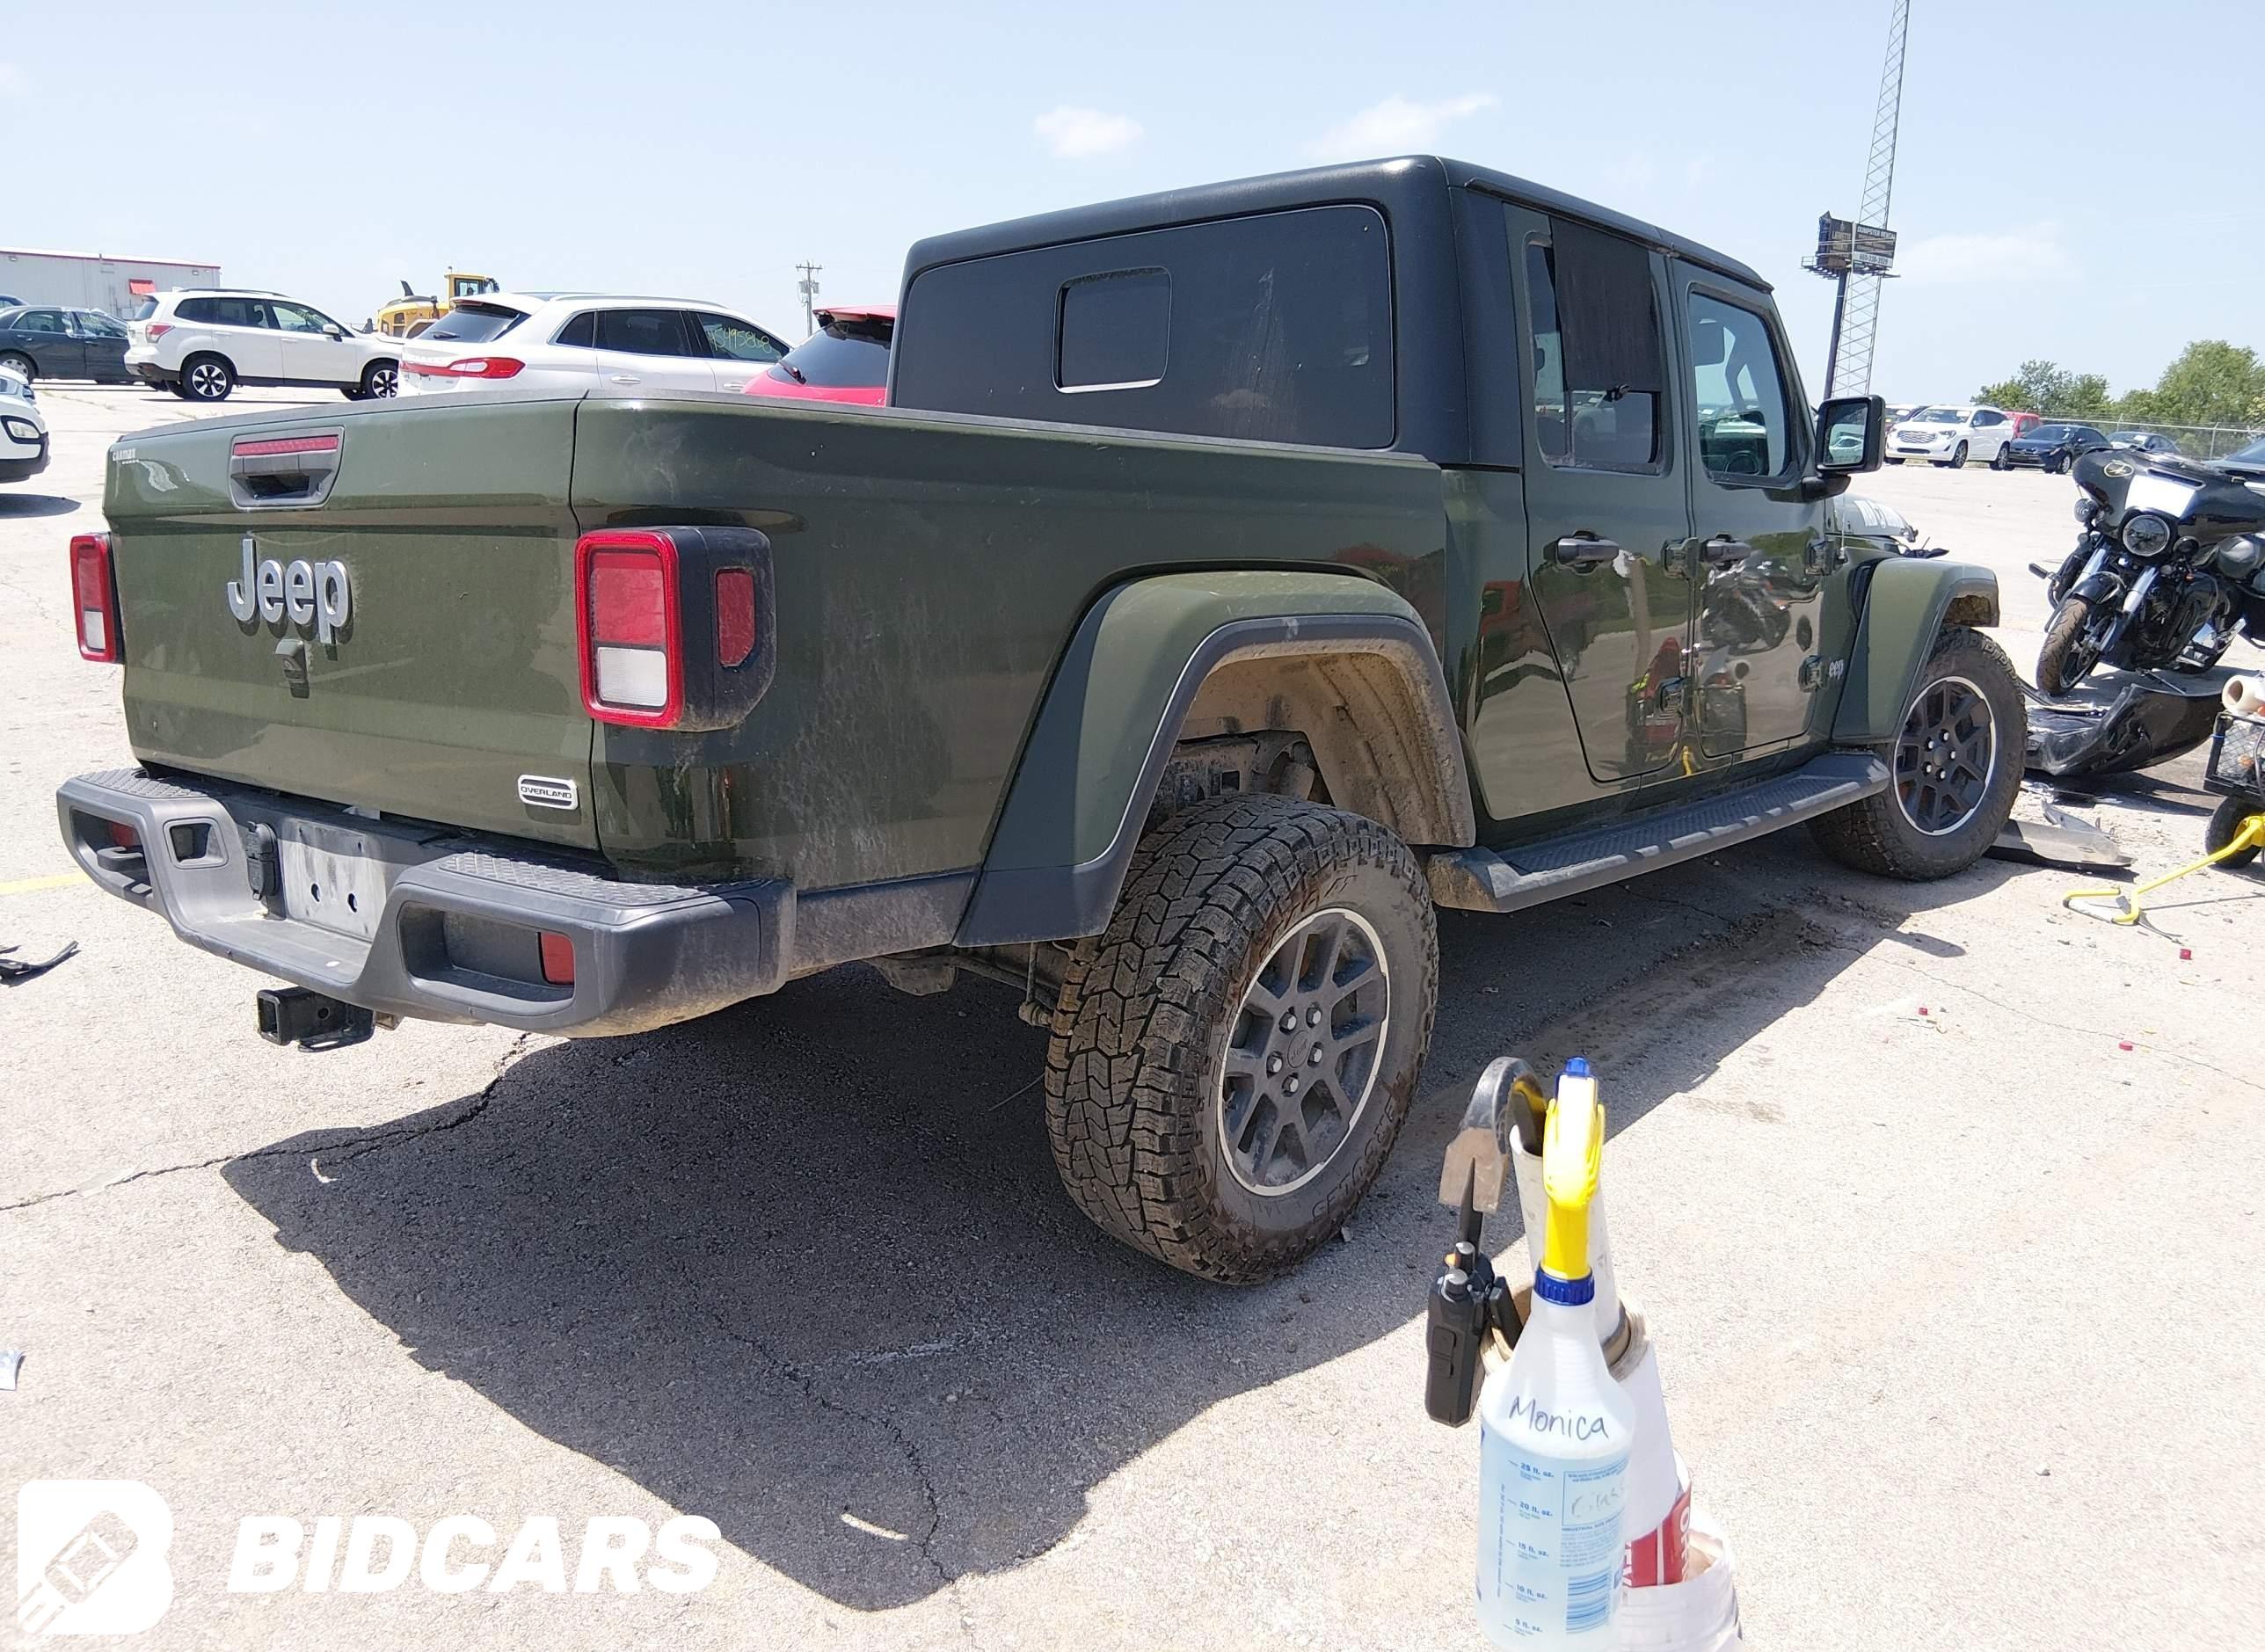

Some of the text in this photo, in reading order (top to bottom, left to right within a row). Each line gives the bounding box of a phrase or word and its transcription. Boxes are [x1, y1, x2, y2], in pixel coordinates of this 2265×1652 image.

[228, 538, 351, 644] Jeep
[521, 785, 572, 799] OVERLAND
[1509, 1395, 1609, 1441] Monica
[1520, 1462, 1531, 1472] 25
[1519, 1500, 1530, 1510] 20
[1518, 1541, 1526, 1550] 15
